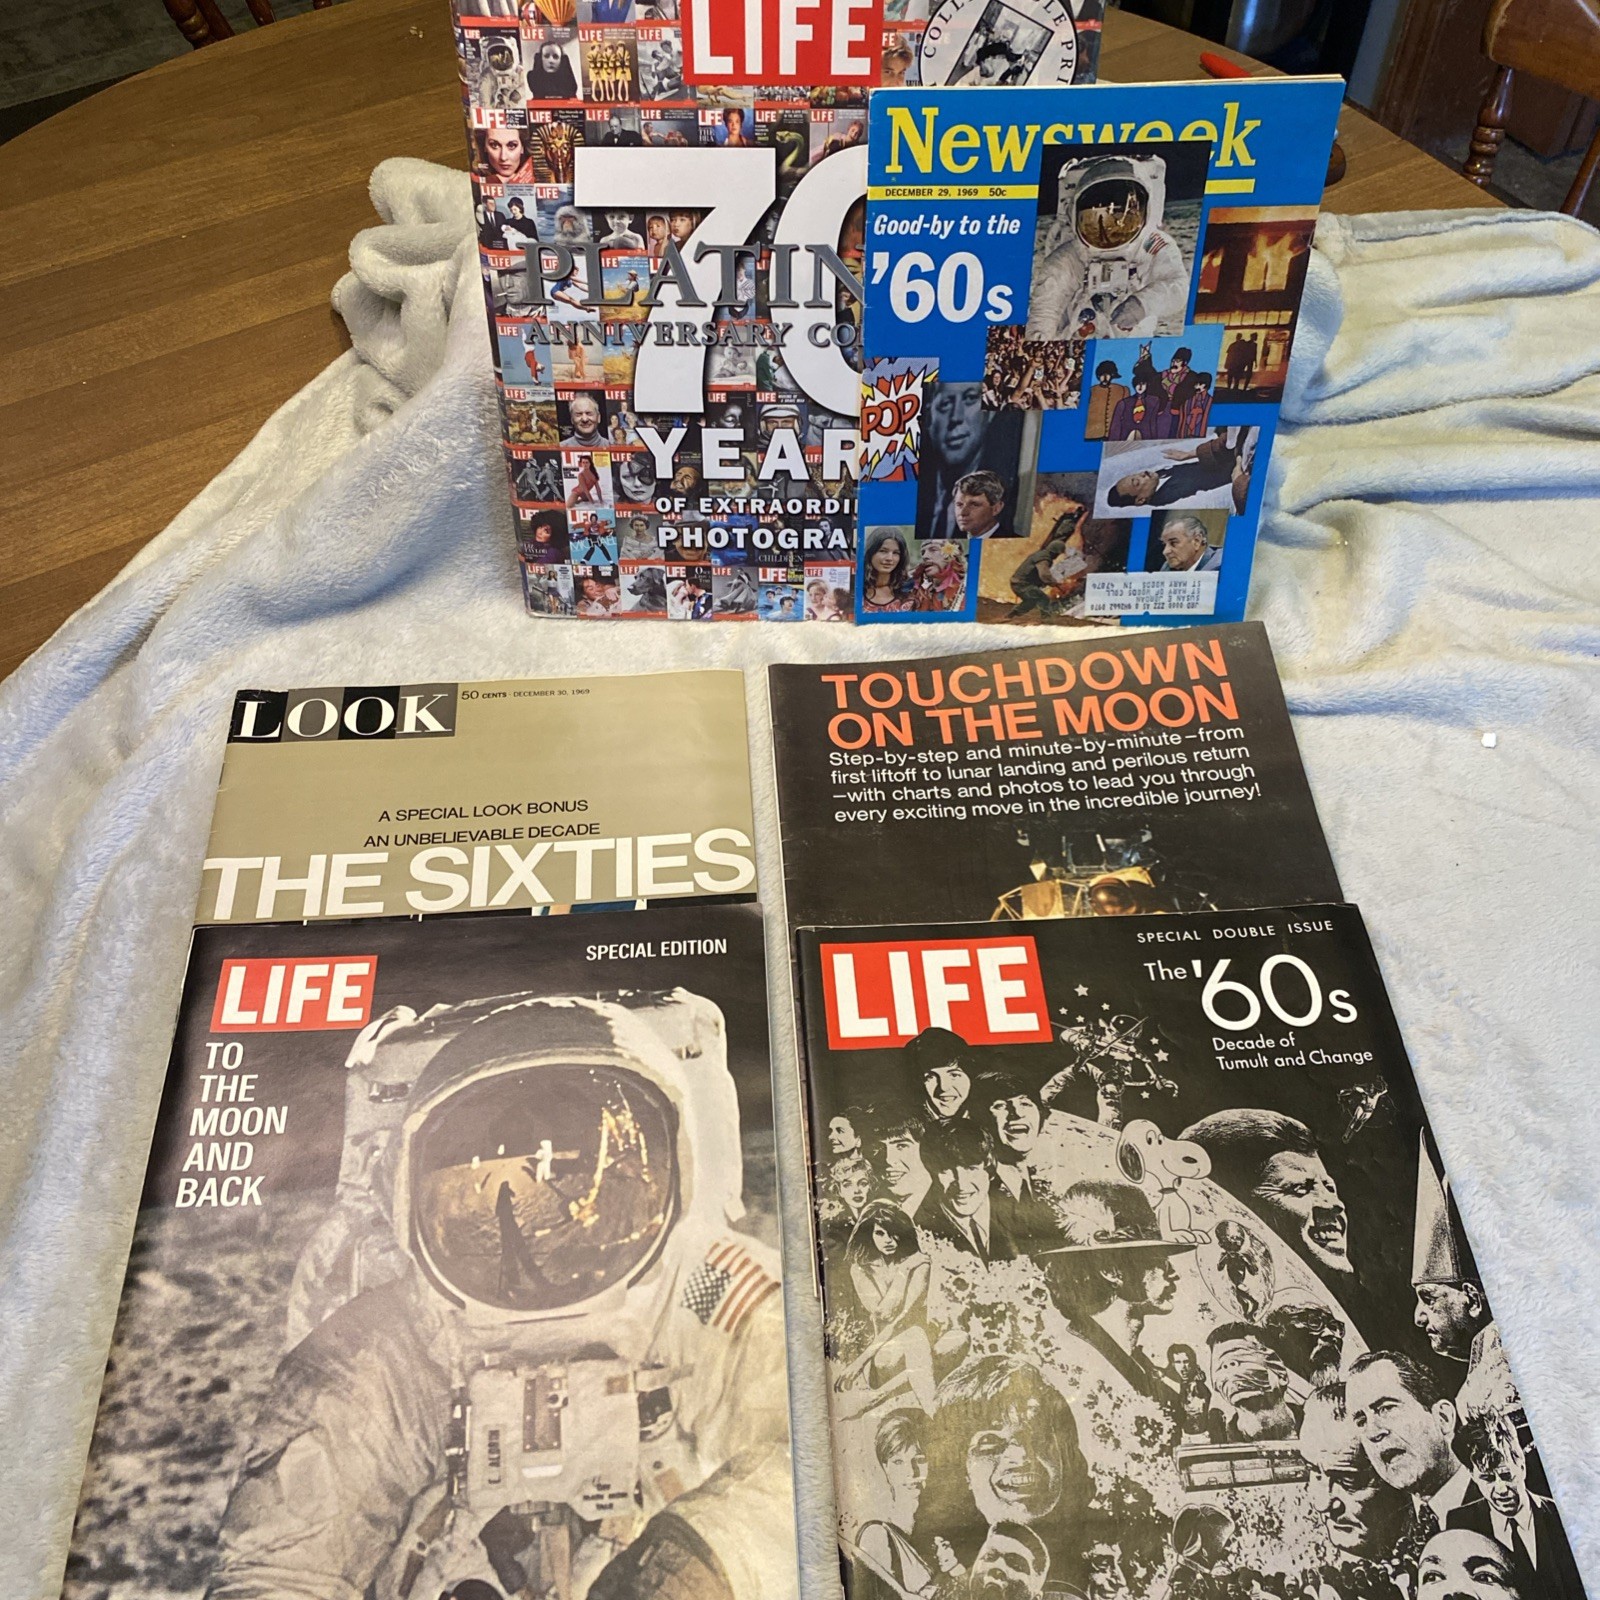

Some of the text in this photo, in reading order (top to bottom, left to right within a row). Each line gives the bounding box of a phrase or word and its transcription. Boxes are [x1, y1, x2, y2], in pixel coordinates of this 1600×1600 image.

[464, 29, 480, 39] LIFE
[521, 28, 544, 40] LIFE
[579, 30, 602, 41] LIFE
[638, 29, 661, 41] LIFE
[691, 0, 871, 76] LIFE
[472, 108, 506, 129] LIFE
[530, 111, 551, 123] LIFE
[586, 109, 609, 120] LIFE
[641, 109, 661, 119] LIFE
[699, 110, 723, 126] LIFE
[755, 111, 776, 123] LIFE
[811, 111, 833, 122] LIFE
[481, 185, 503, 197] LIFE
[537, 187, 558, 199] LIFE
[885, 187, 1007, 197] DECEMBER 29, 1969 50c
[873, 214, 1021, 240] Good-by to the
[490, 257, 510, 267] LIFE
[543, 258, 558, 270] LIF
[602, 257, 618, 268] IFE
[516, 237, 864, 308] PLATIN
[871, 251, 1014, 324] '60s
[498, 326, 518, 336] LIFE
[524, 318, 864, 348] ANNIVERSARY CO
[505, 389, 525, 399] LIFE
[557, 391, 575, 401] LIFE
[605, 390, 626, 400] LIFE
[707, 392, 726, 402] LIFE
[756, 392, 776, 402] LIFE
[861, 393, 921, 444] POP
[512, 450, 532, 459] LIFE
[611, 452, 631, 462] LIFE
[634, 427, 860, 481] YEAR
[804, 453, 823, 462] LIF
[655, 497, 859, 516] OF EXTRAORDI
[519, 508, 539, 521] LIF
[616, 510, 632, 518] LIFE
[710, 514, 728, 523] LIFE
[658, 527, 857, 549] PHOTOGRA
[758, 554, 803, 563] CHILDREN
[527, 565, 545, 575] LIFE
[573, 566, 593, 576] LIFE
[620, 566, 639, 575] LIFE
[667, 566, 686, 577] LIFE
[713, 567, 731, 576] LIFE
[758, 568, 787, 582] LIFE
[805, 568, 823, 577] LIFE
[1169, 580, 1188, 588] MARY
[821, 639, 1228, 709] TOUCHDOWN
[461, 690, 480, 701] 50
[482, 691, 507, 700] CENTS
[513, 690, 556, 698] DECEMBER
[571, 688, 591, 696] 1969
[233, 693, 453, 739] LOOK
[828, 682, 1239, 750] ON THE MOON
[829, 750, 959, 767] Step-by-step
[966, 745, 1001, 760] and
[1009, 729, 1182, 758] minute-by-minute
[831, 746, 1250, 784] first liftoff to lunar landing and perilous return
[892, 786, 952, 801] charts
[957, 783, 992, 798] and
[998, 779, 1064, 798] photos
[1068, 777, 1088, 791] to
[1093, 773, 1134, 790] lead
[1139, 772, 1176, 789] you
[1180, 763, 1256, 783] through
[834, 782, 1262, 823] every exciting move in the incredible journey!
[378, 799, 589, 823] A SPECIAL LOOK BONUS
[363, 822, 601, 848] AN UNBELIEVABLE DECADE
[202, 828, 756, 921] THE SIXTIES
[1136, 920, 1334, 944] SPECIAL DOUBLE ISSUE
[585, 937, 728, 962] SPECIAL EDITION
[221, 962, 370, 1025] LIFE
[832, 947, 1040, 1039] LIFE
[1143, 953, 1358, 1031] The '60s
[1212, 1031, 1297, 1052] Decade of
[205, 1042, 244, 1070] TO
[1215, 1049, 1373, 1071] Tumult and Change
[199, 1074, 259, 1103] THE
[189, 1105, 289, 1137] MOON
[182, 1141, 254, 1172] AND
[175, 1175, 266, 1208] BACK
